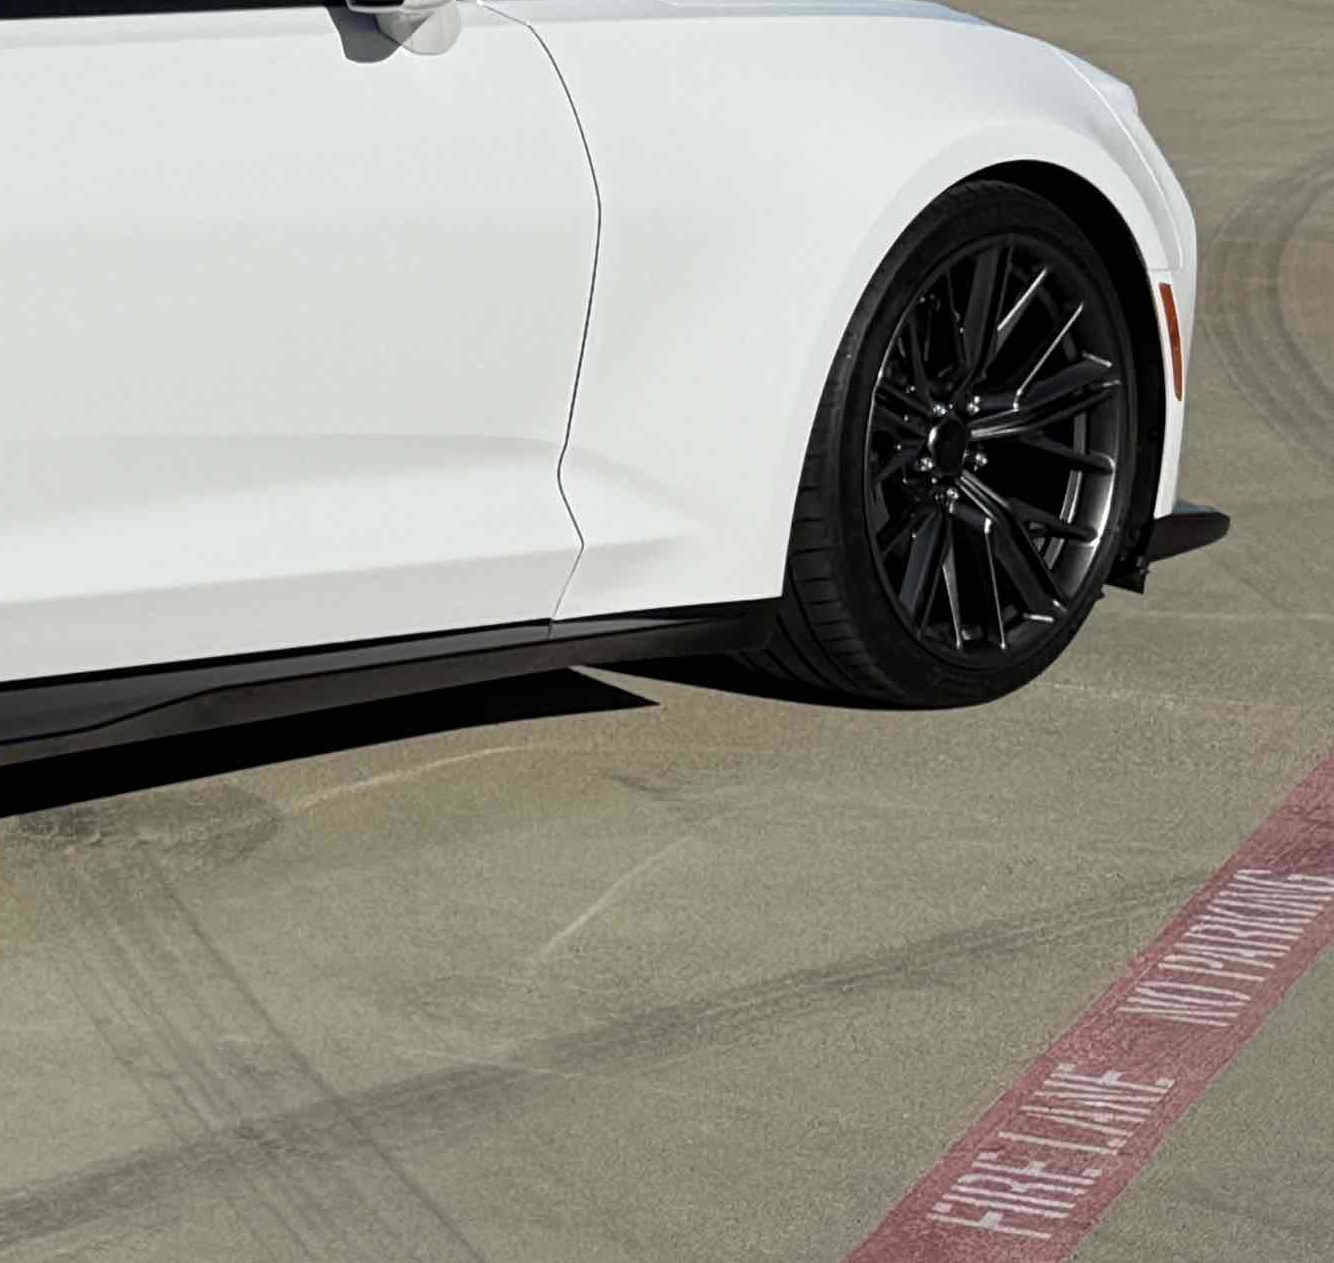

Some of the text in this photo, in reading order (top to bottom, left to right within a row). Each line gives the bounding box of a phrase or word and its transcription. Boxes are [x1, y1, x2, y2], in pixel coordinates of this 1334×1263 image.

[928, 869, 1334, 1238] FIRE LANE NO PARKING
